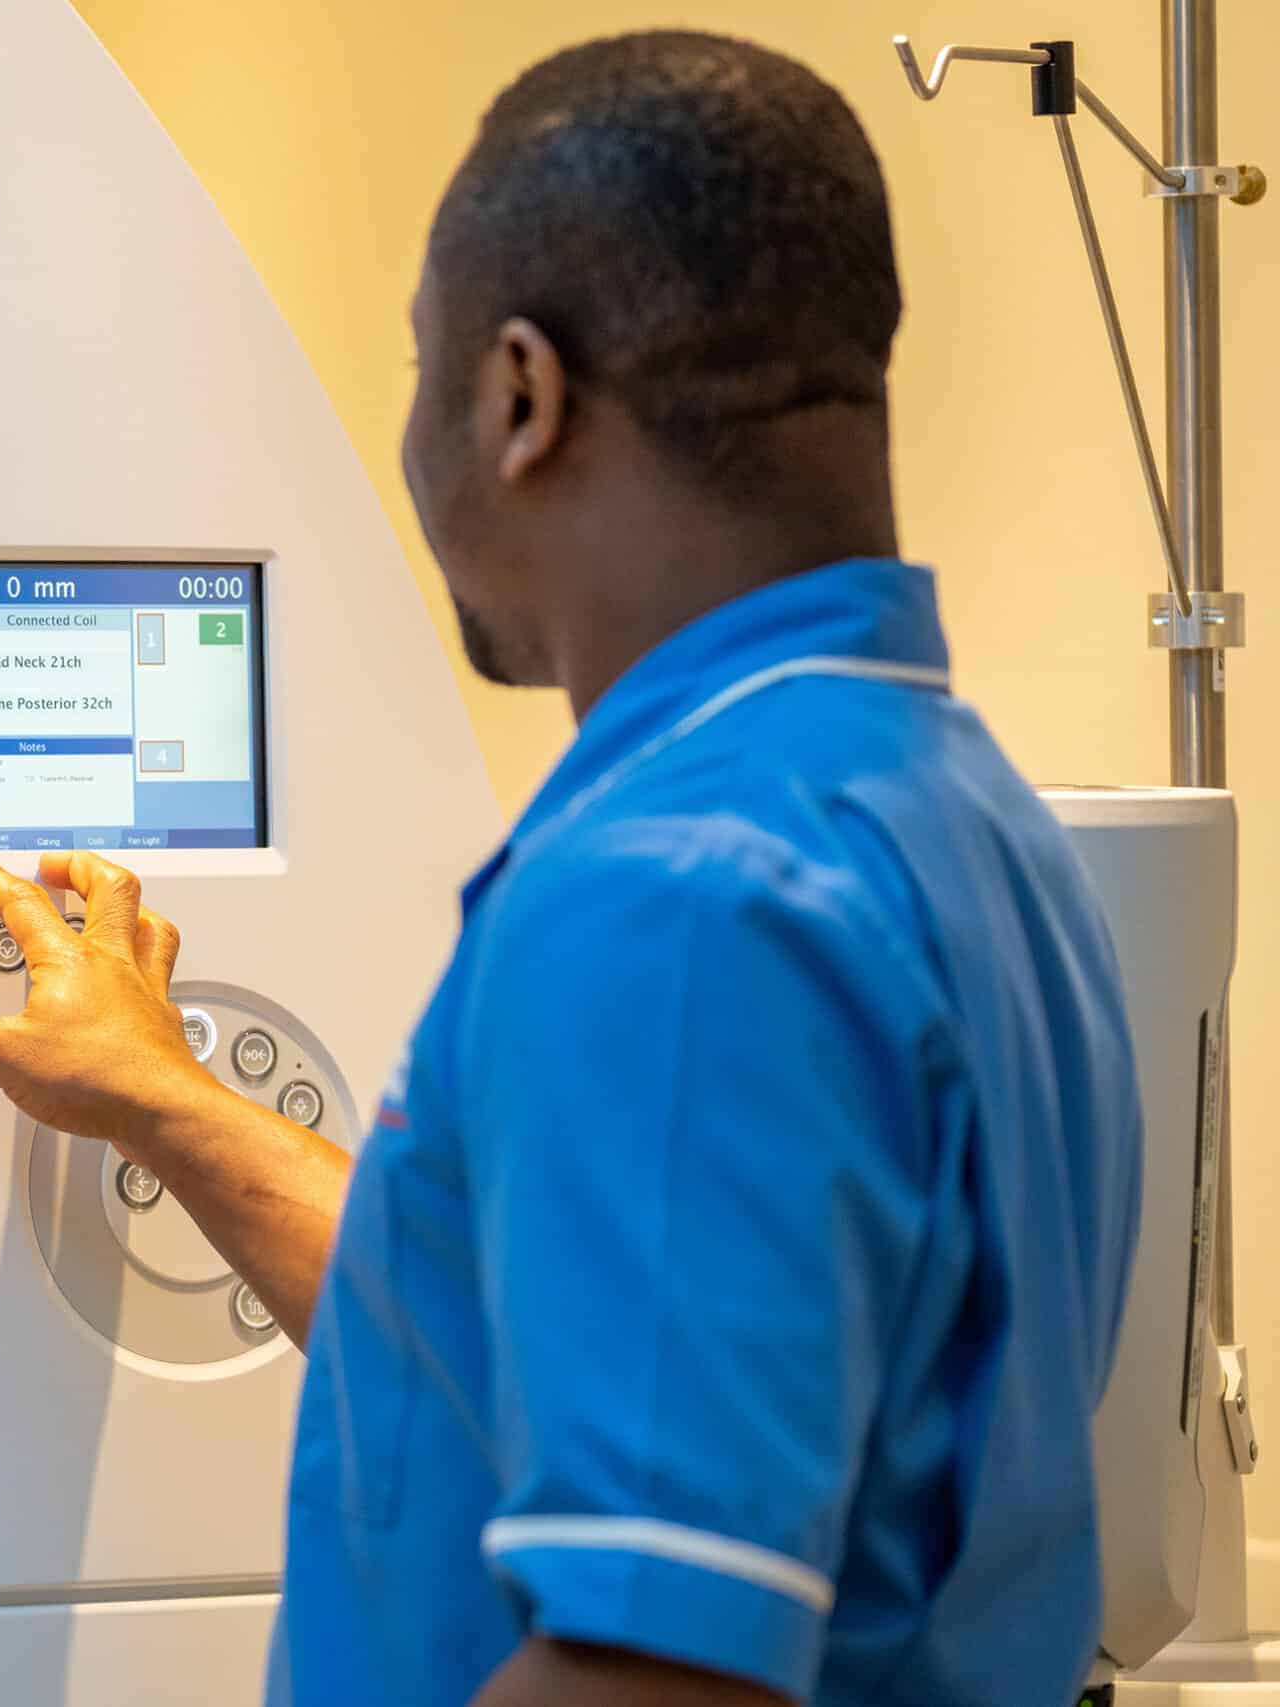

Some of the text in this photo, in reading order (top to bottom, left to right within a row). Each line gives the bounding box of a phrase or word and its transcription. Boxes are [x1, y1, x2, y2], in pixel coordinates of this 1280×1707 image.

[7, 576, 76, 599] 0 mm
[179, 576, 243, 599] 00:00
[6, 614, 97, 626] Connected Coil
[215, 621, 227, 638] 2
[145, 632, 156, 648] 1
[14, 656, 46, 668] Neck
[50, 656, 82, 668] 21ch
[17, 697, 78, 710] Posterior
[81, 697, 113, 710] 32ch
[19, 741, 47, 753] Notes
[156, 748, 168, 766] 4
